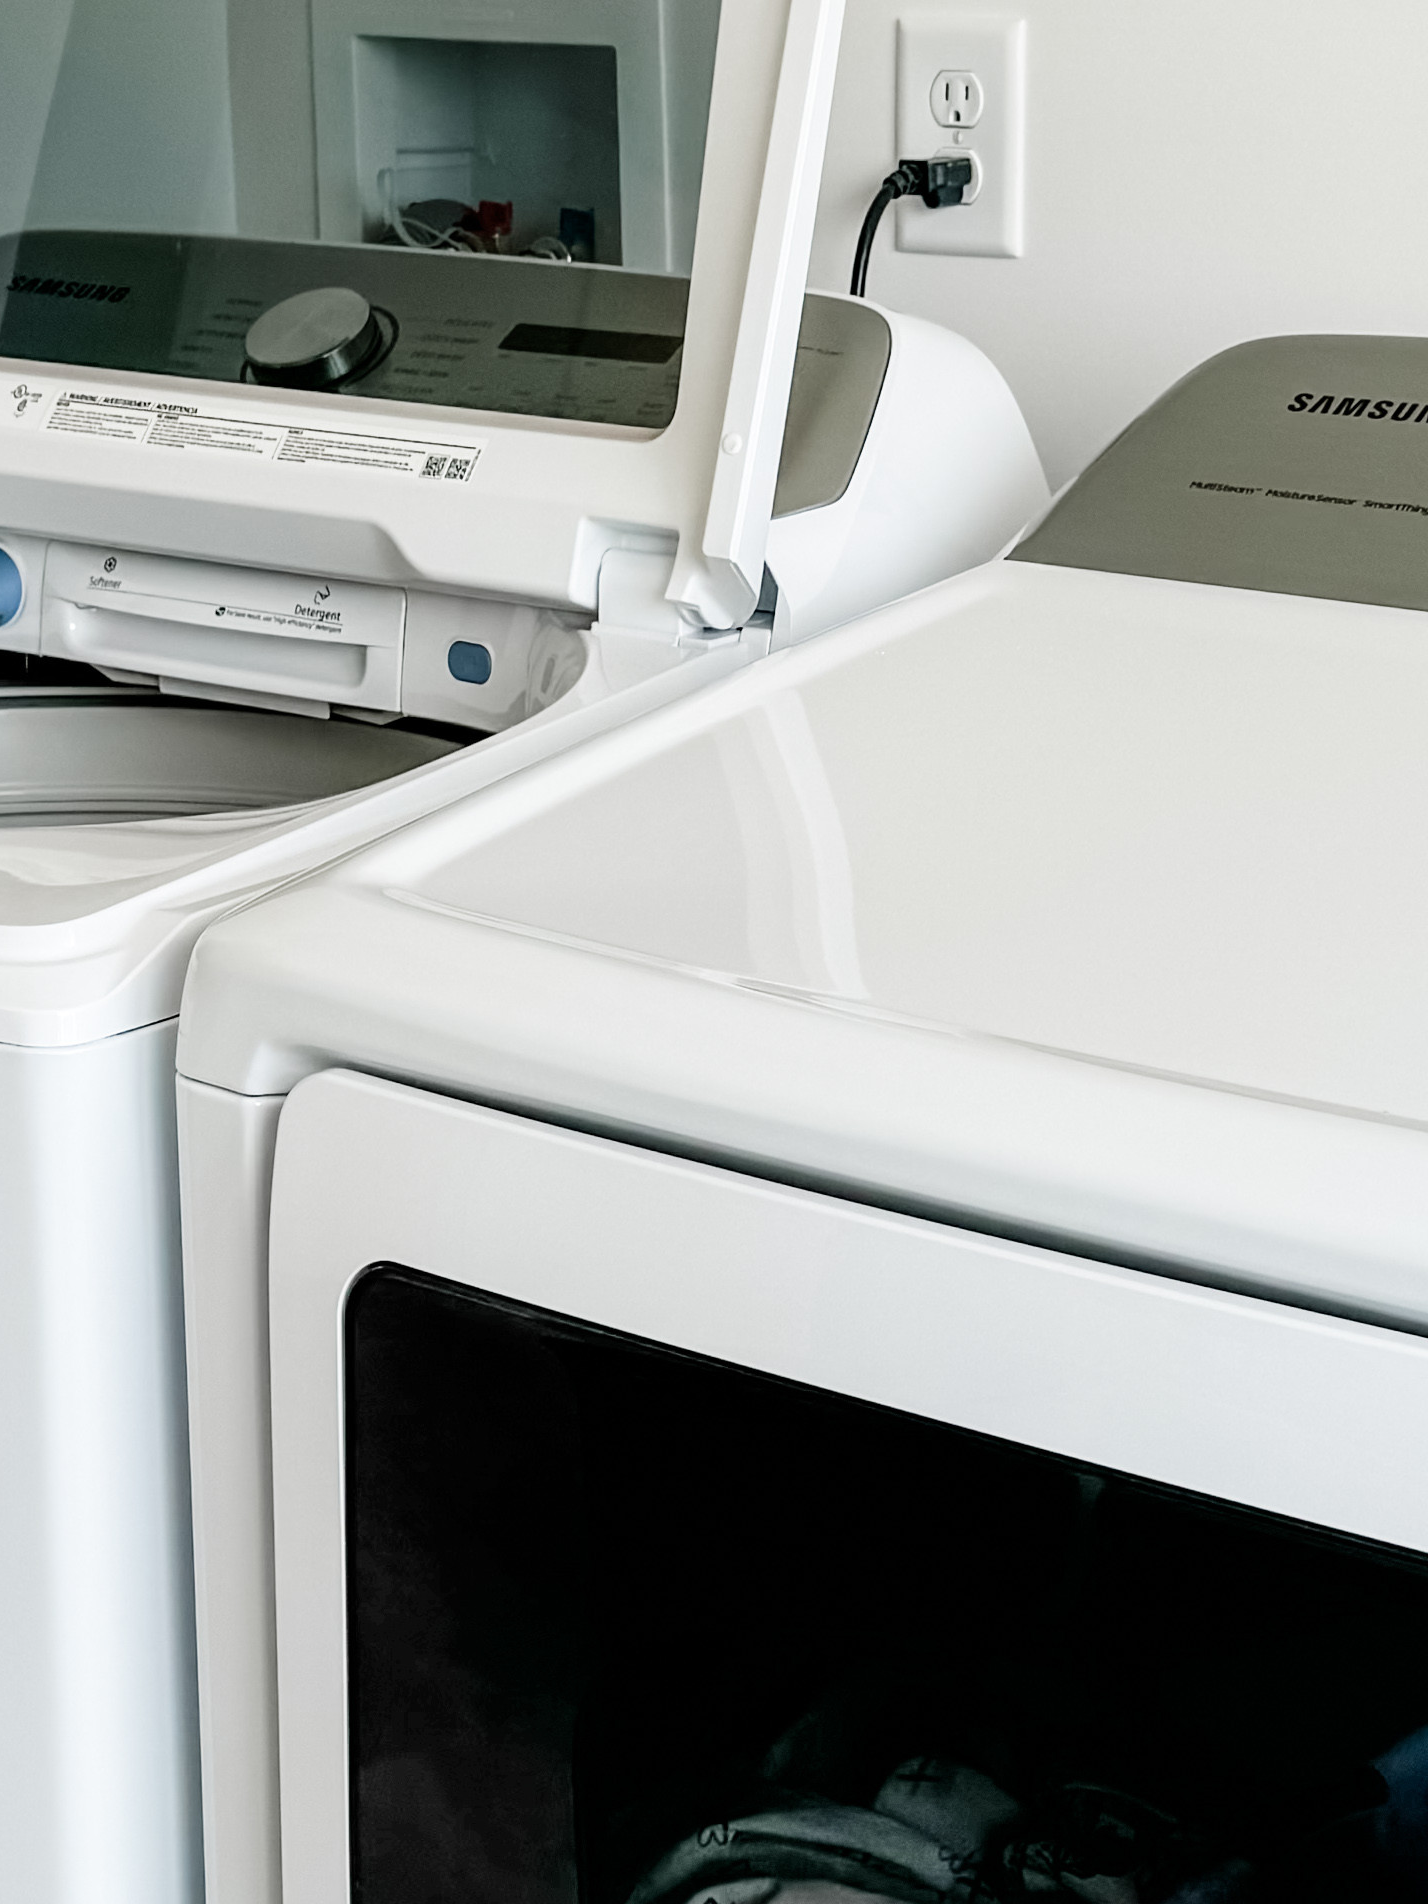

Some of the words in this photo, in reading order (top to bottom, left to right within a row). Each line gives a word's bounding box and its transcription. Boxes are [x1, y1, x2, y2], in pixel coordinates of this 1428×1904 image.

[6, 275, 131, 303] SAMSUNG
[89, 575, 122, 589] Softener
[294, 603, 341, 621] Detergent
